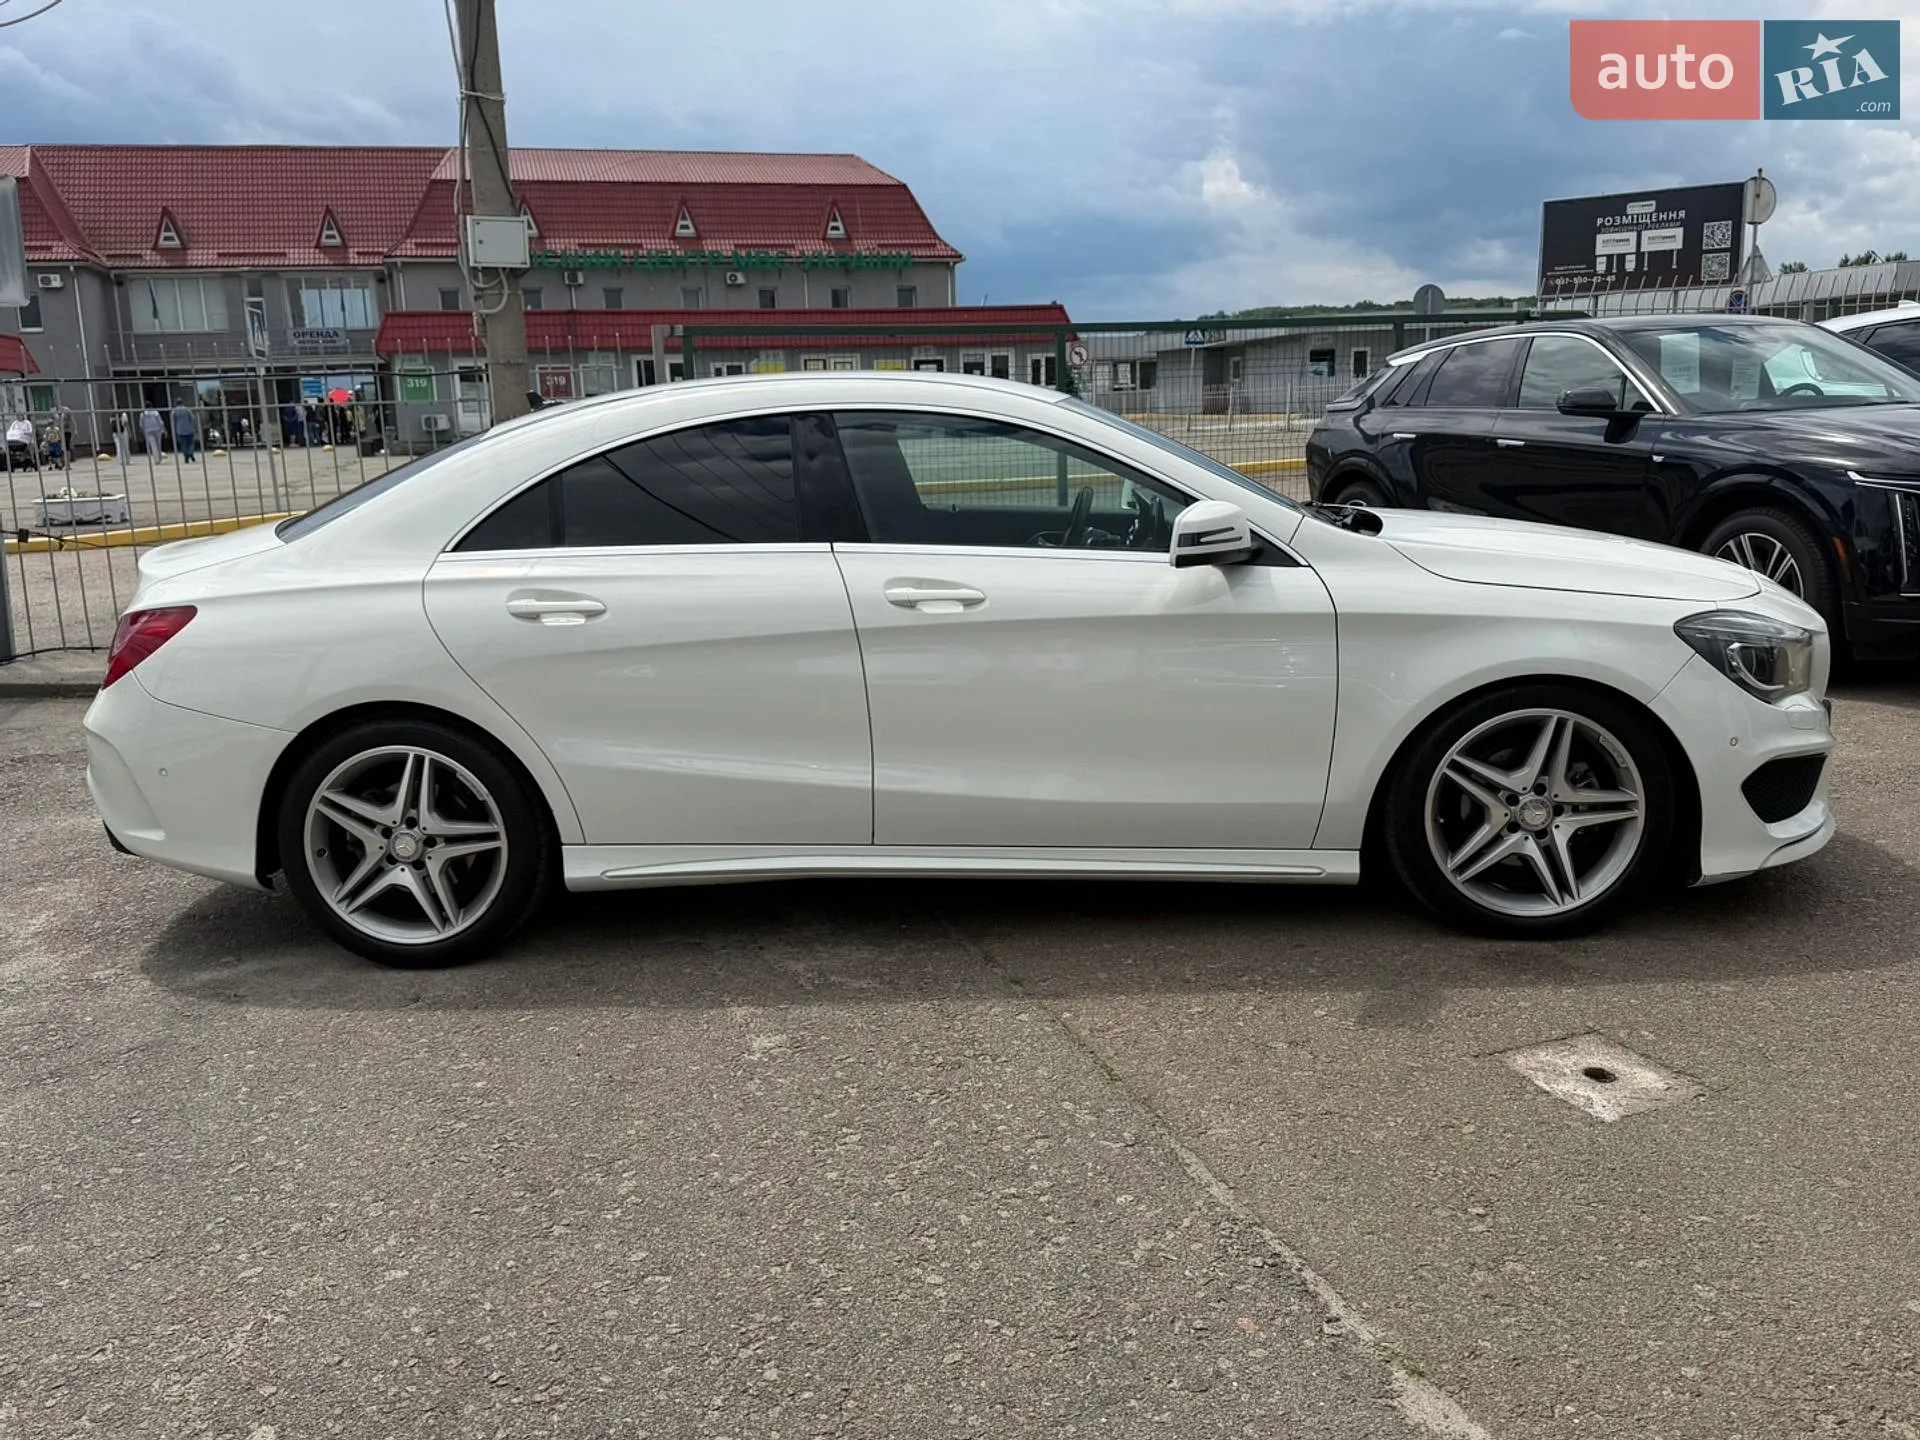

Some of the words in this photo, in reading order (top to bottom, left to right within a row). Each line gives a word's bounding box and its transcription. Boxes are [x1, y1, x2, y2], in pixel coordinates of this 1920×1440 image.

[1596, 209, 1686, 227] РОЗМІЩЕННЯ
[293, 330, 340, 339] ОРЕНДА
[407, 378, 428, 389] 319
